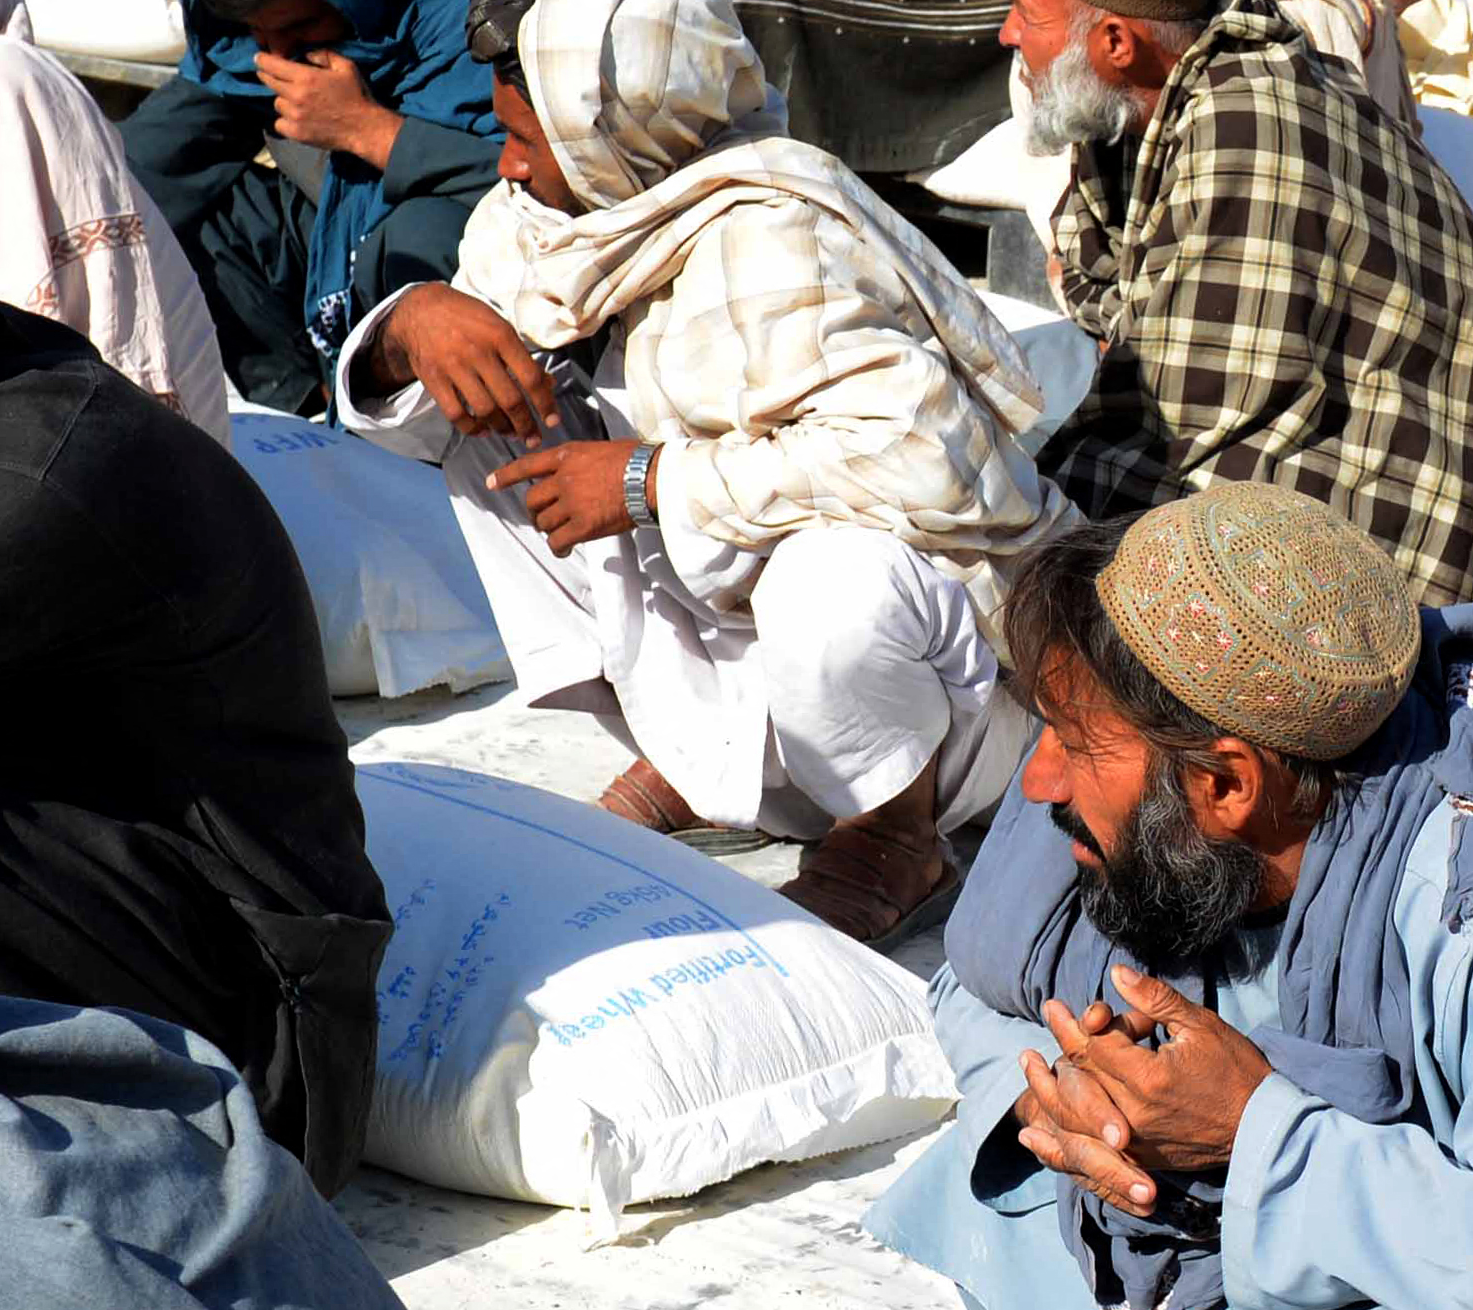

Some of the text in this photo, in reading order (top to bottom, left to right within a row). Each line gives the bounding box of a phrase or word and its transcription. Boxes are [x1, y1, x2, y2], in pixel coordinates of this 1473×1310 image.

[562, 901, 621, 931] Net
[642, 909, 723, 940] Flour
[648, 944, 767, 998] Fortified
